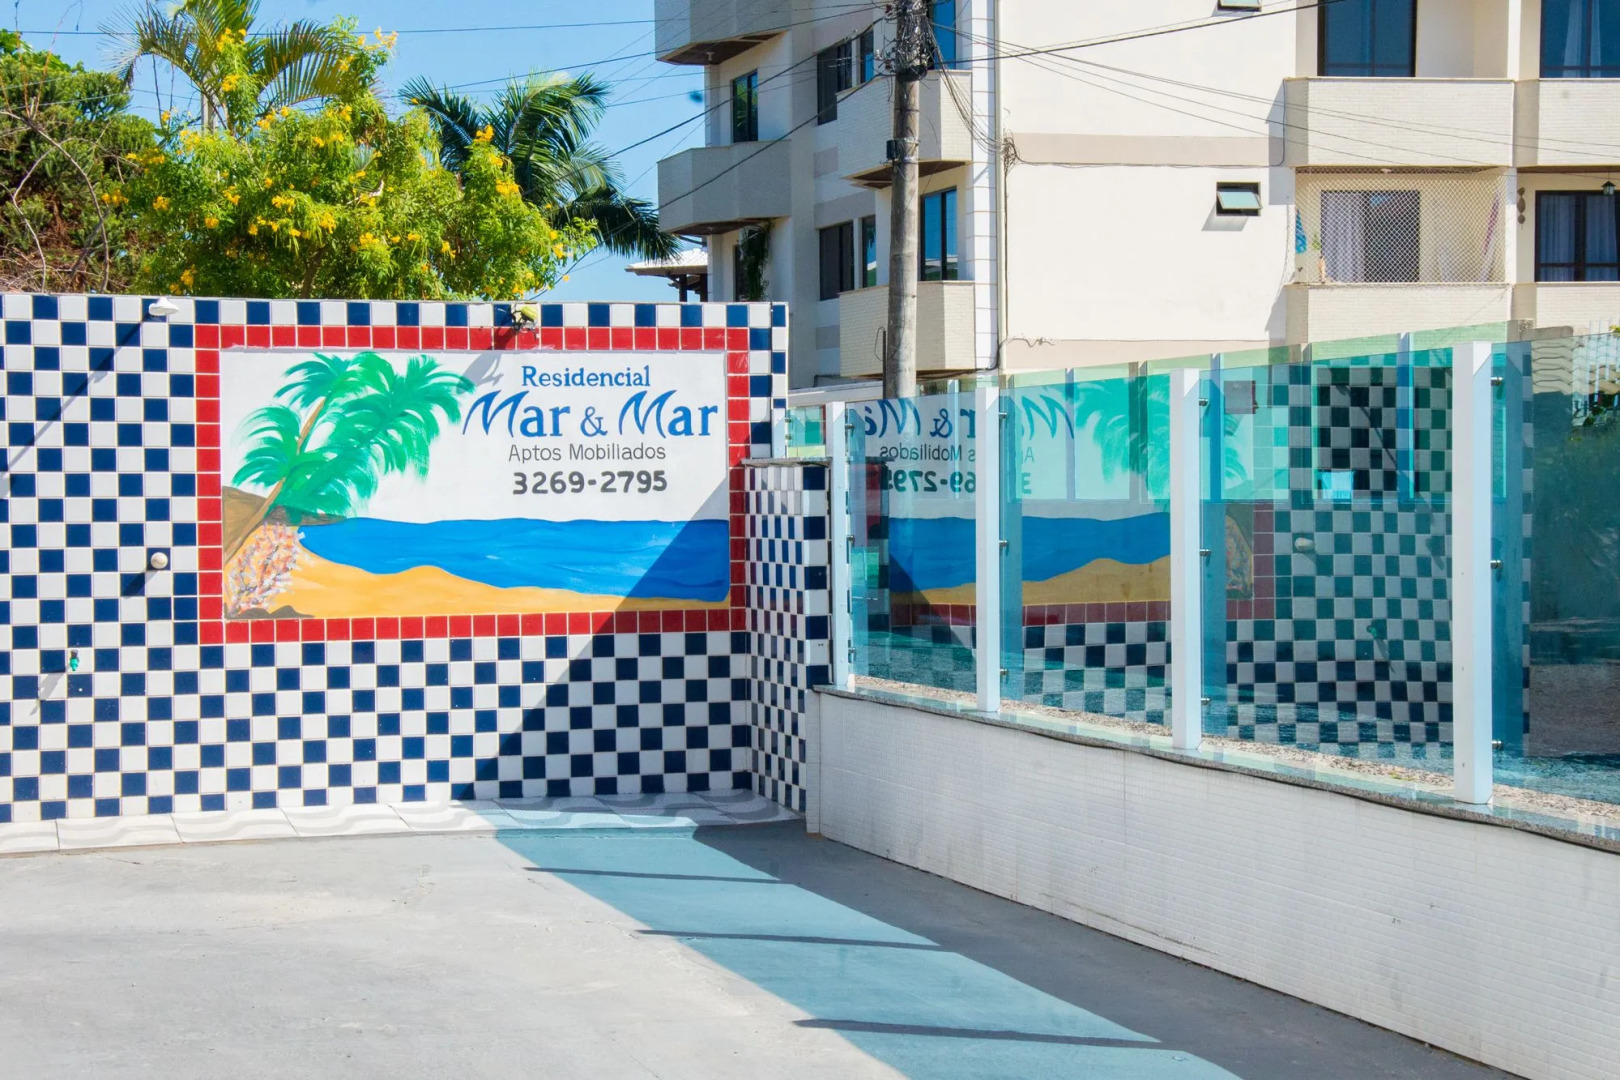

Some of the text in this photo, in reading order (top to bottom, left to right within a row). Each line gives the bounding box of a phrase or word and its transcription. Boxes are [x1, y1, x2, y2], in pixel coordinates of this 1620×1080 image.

[521, 365, 650, 387] Residencial
[462, 389, 718, 438] Mar & Mar
[508, 442, 666, 463] Aptos Mobiliados
[512, 470, 668, 495] 3269-2795
